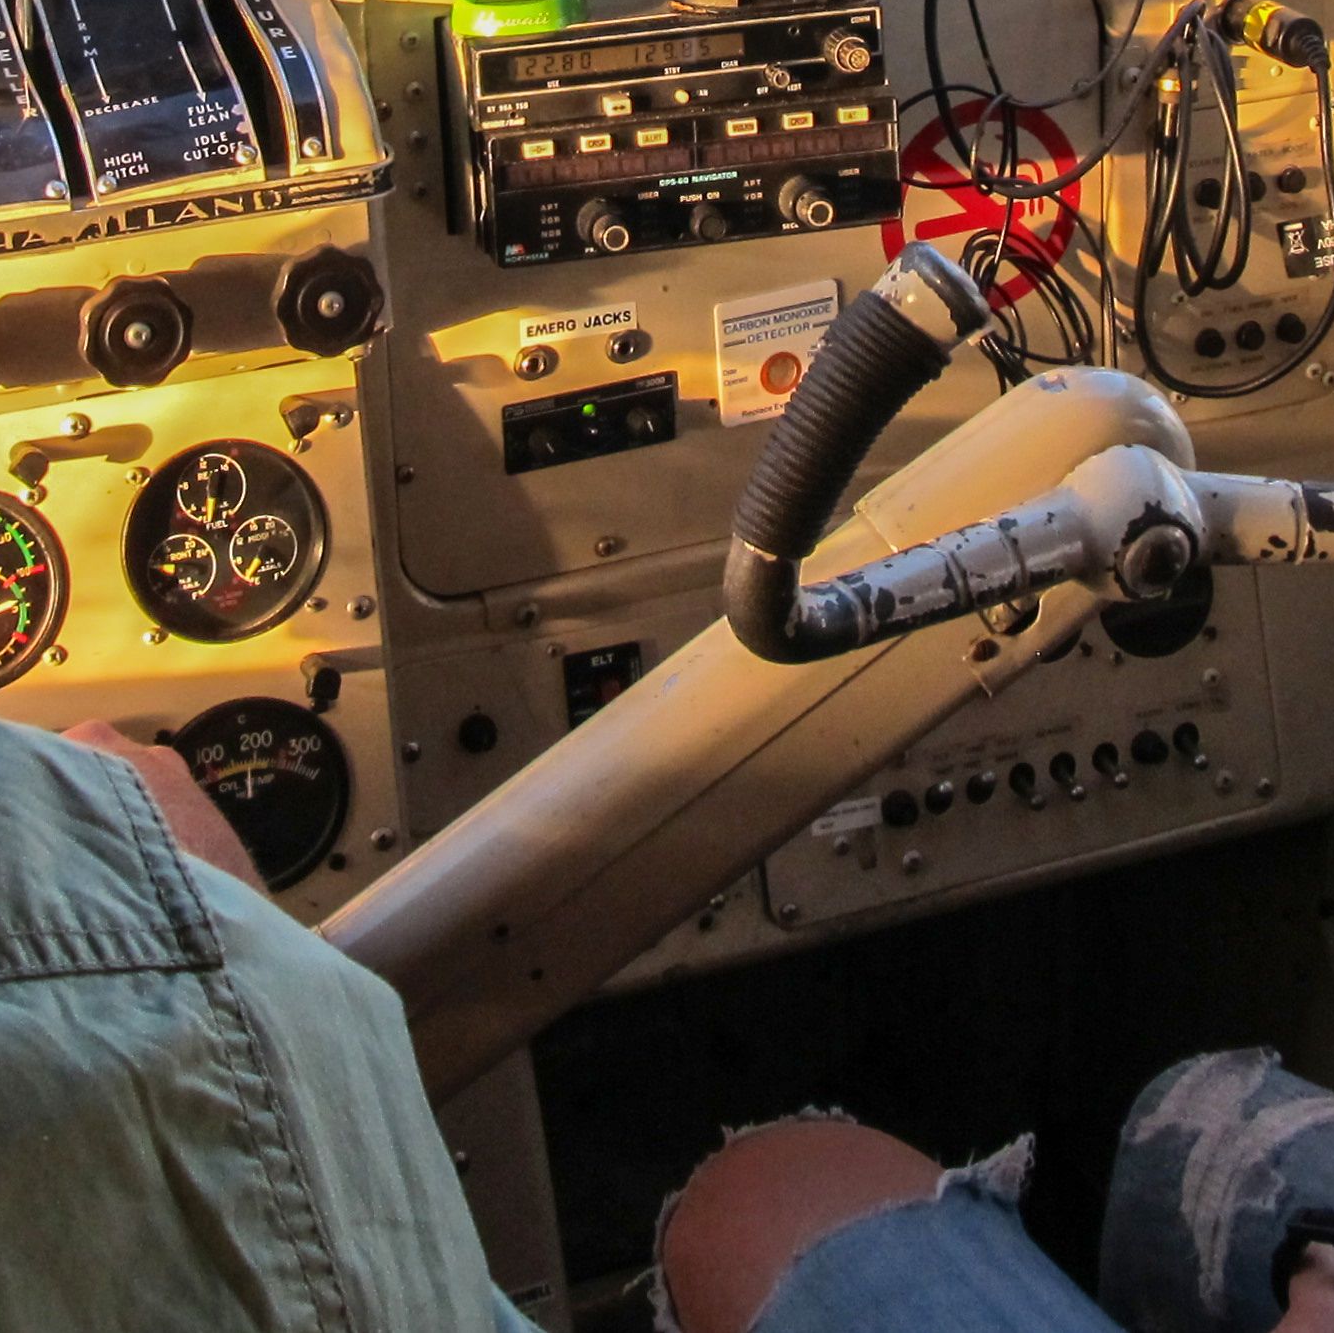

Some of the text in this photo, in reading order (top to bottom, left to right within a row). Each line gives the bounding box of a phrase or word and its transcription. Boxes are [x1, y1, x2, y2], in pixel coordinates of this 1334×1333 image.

[84, 95, 160, 118] DECREASE
[187, 102, 224, 116] FULL
[188, 110, 230, 128] LEAN
[194, 131, 228, 147] IDLE
[103, 151, 144, 168] HIGH
[691, 171, 738, 183] NAVIGATOR
[638, 191, 659, 200] USER
[680, 191, 721, 202] PUSH ON
[505, 252, 549, 263] NORTHSTAR
[526, 311, 631, 337] EMERG JACKS
[723, 303, 832, 335] CARBON MONOXIDE
[747, 322, 811, 344] DETECTOR
[206, 520, 228, 530] FUEL
[265, 521, 275, 530] 20
[185, 540, 196, 549] 20
[591, 653, 614, 666] ELT
[240, 730, 273, 751] 200
[288, 735, 321, 756] 300
[197, 744, 225, 764] 100
[219, 781, 239, 793] CYL
